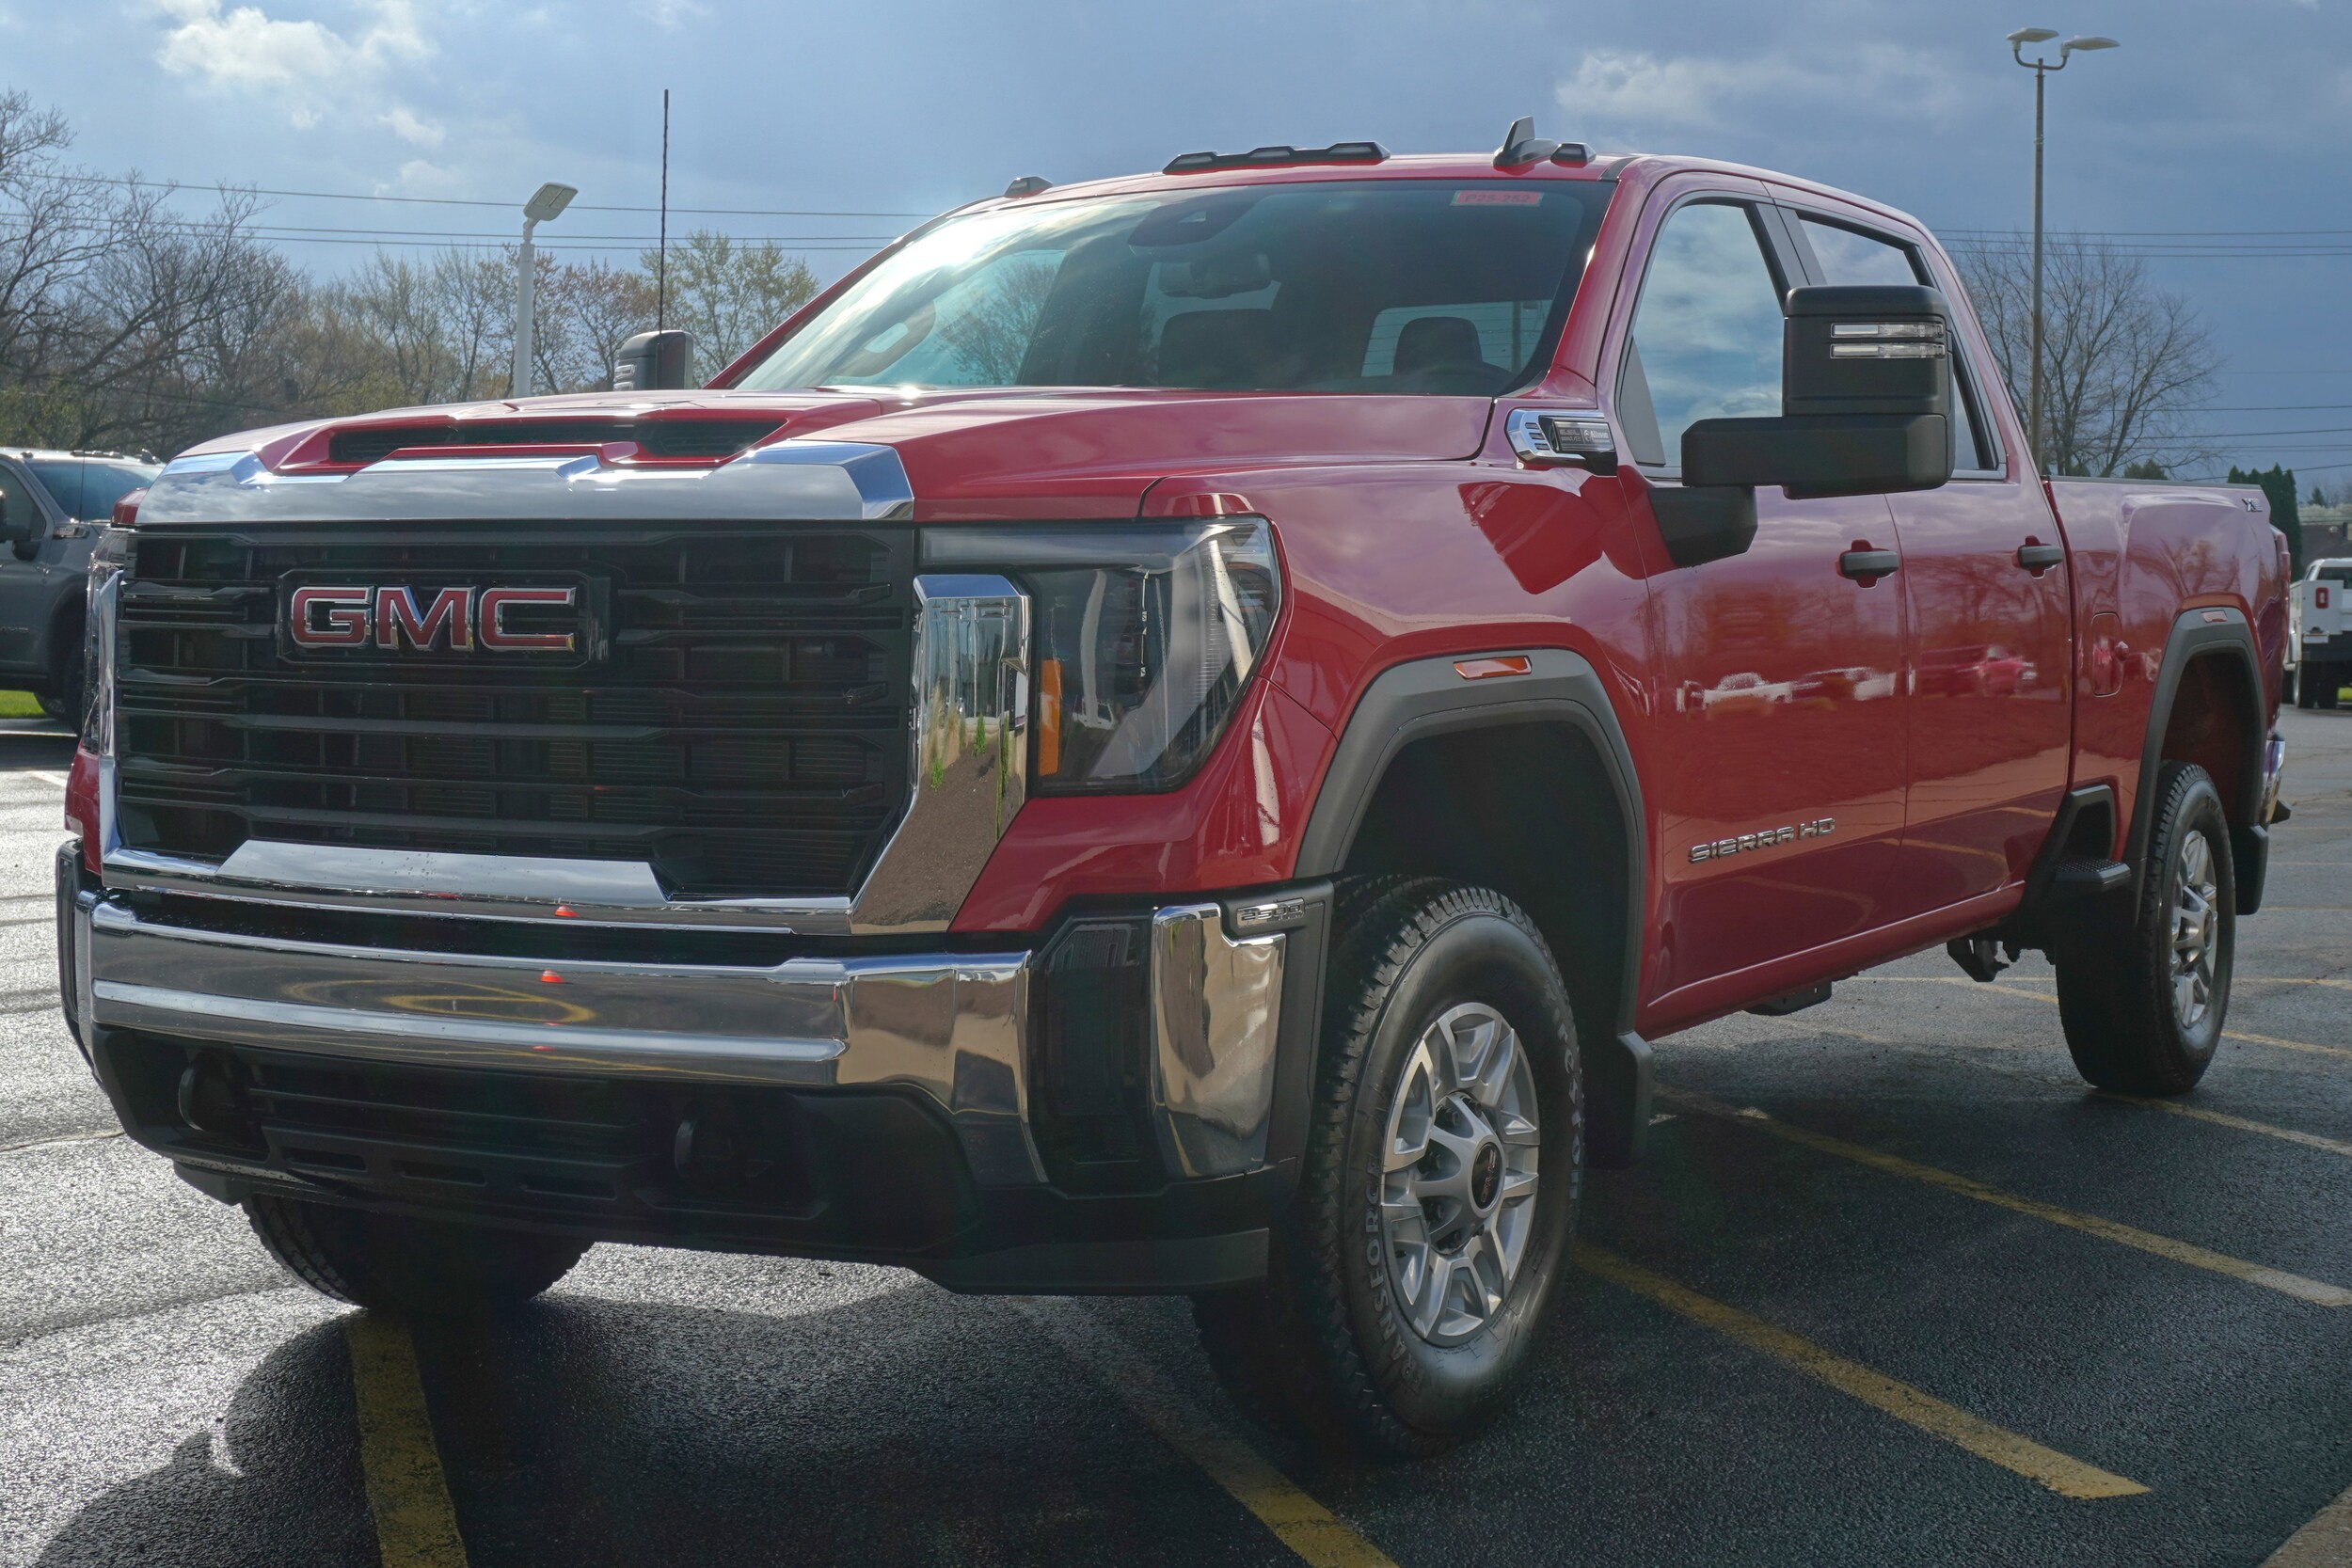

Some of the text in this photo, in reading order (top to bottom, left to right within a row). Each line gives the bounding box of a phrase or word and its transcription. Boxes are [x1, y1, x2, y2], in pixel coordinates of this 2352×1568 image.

[291, 585, 576, 652] GMC
[1688, 817, 1836, 863] SIERRA HD
